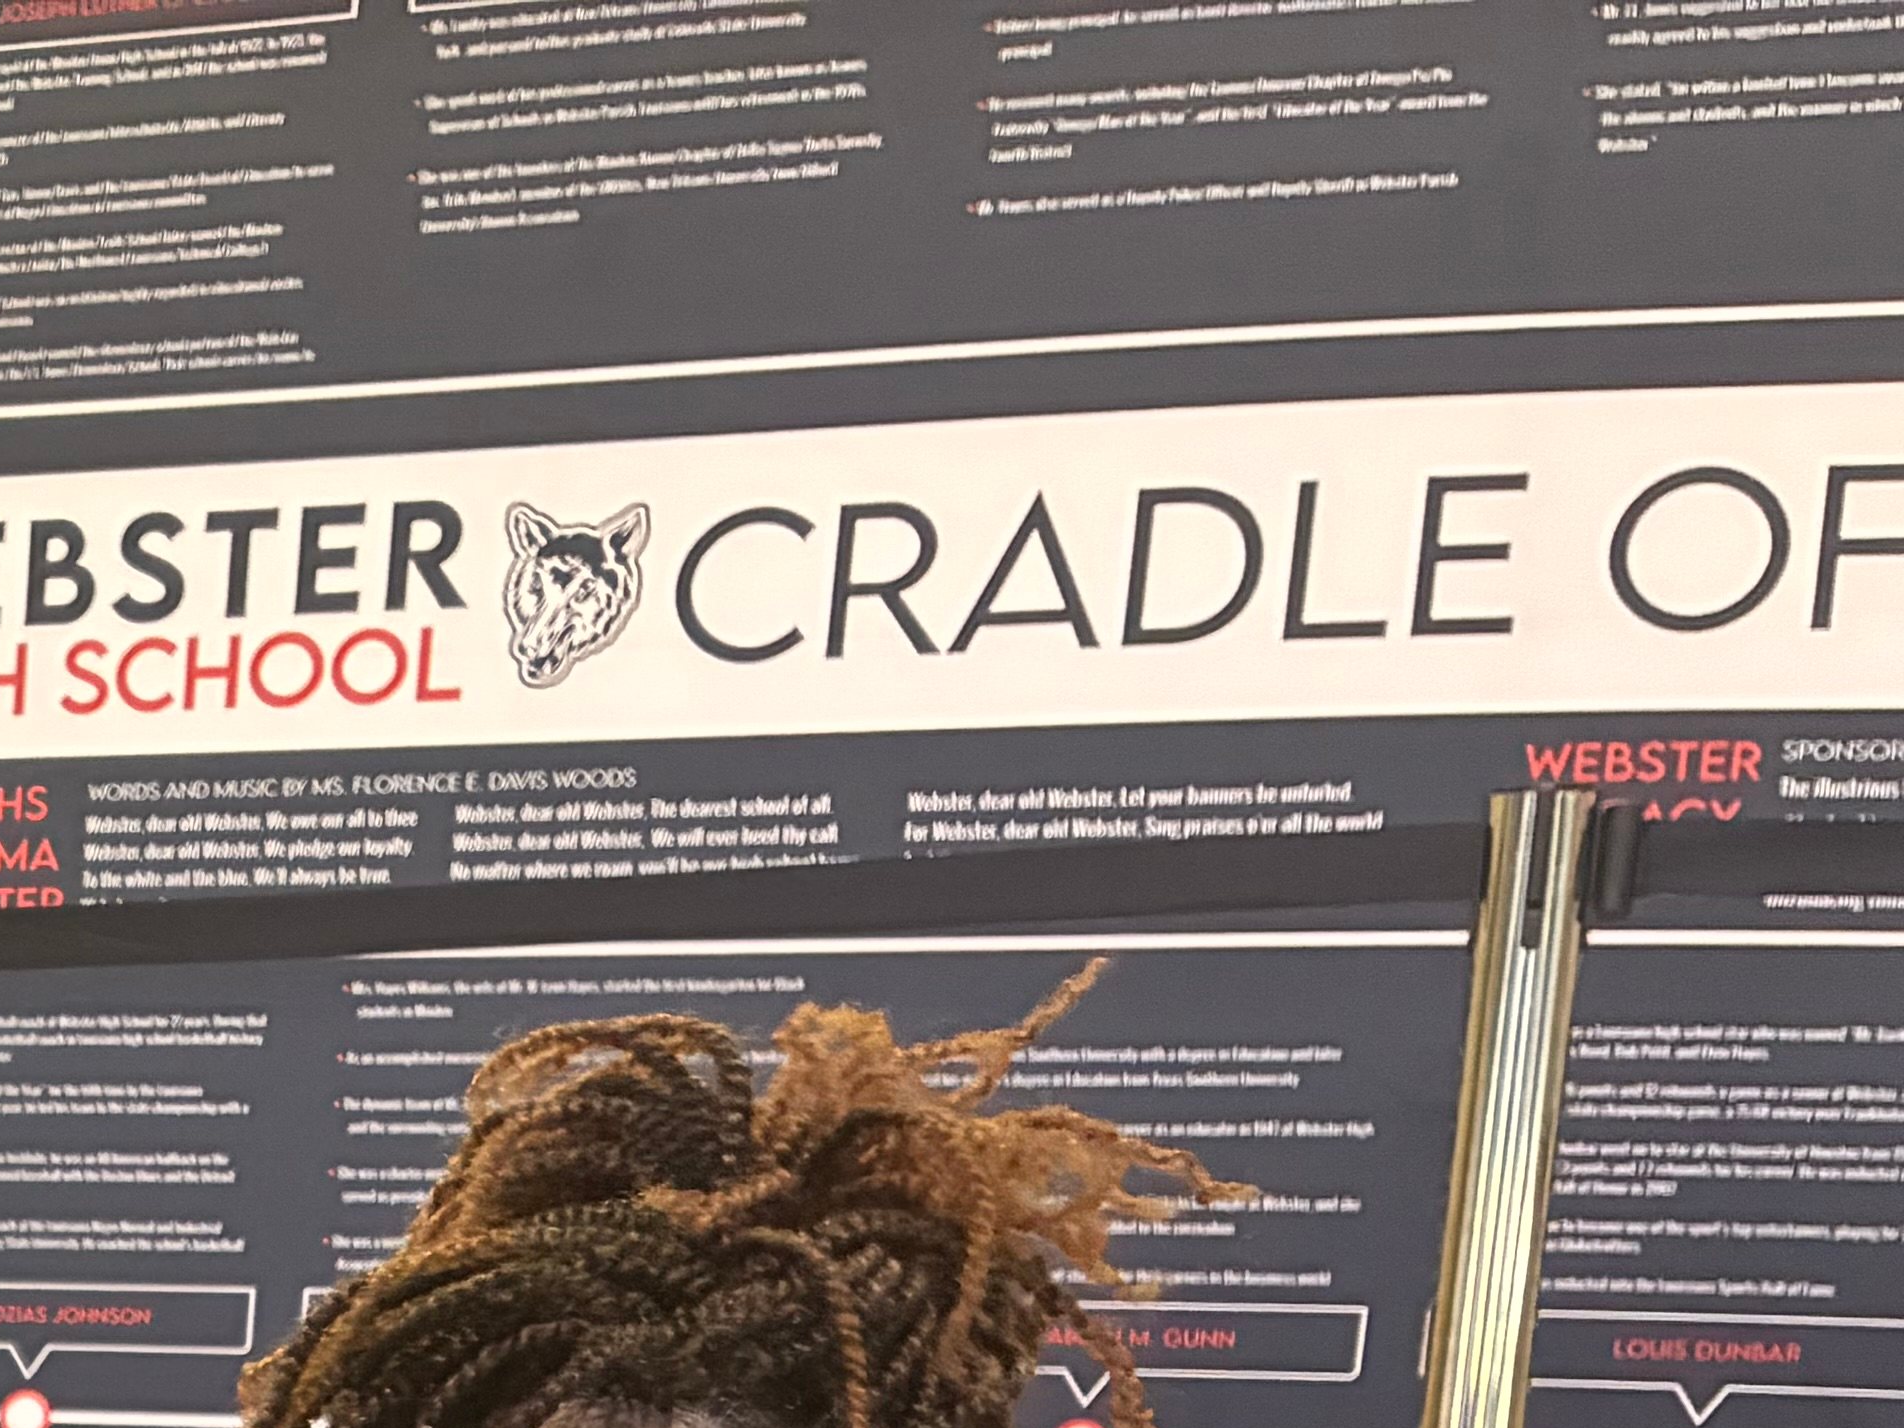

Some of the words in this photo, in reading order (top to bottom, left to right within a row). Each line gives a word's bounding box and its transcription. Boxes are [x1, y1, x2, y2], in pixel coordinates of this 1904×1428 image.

[674, 470, 1532, 665] CRADLE
[1607, 462, 1904, 634] OF
[60, 626, 462, 717] SCHOOL
[1526, 741, 1761, 782] WEBSTER
[1612, 1337, 1687, 1364] LOUIS
